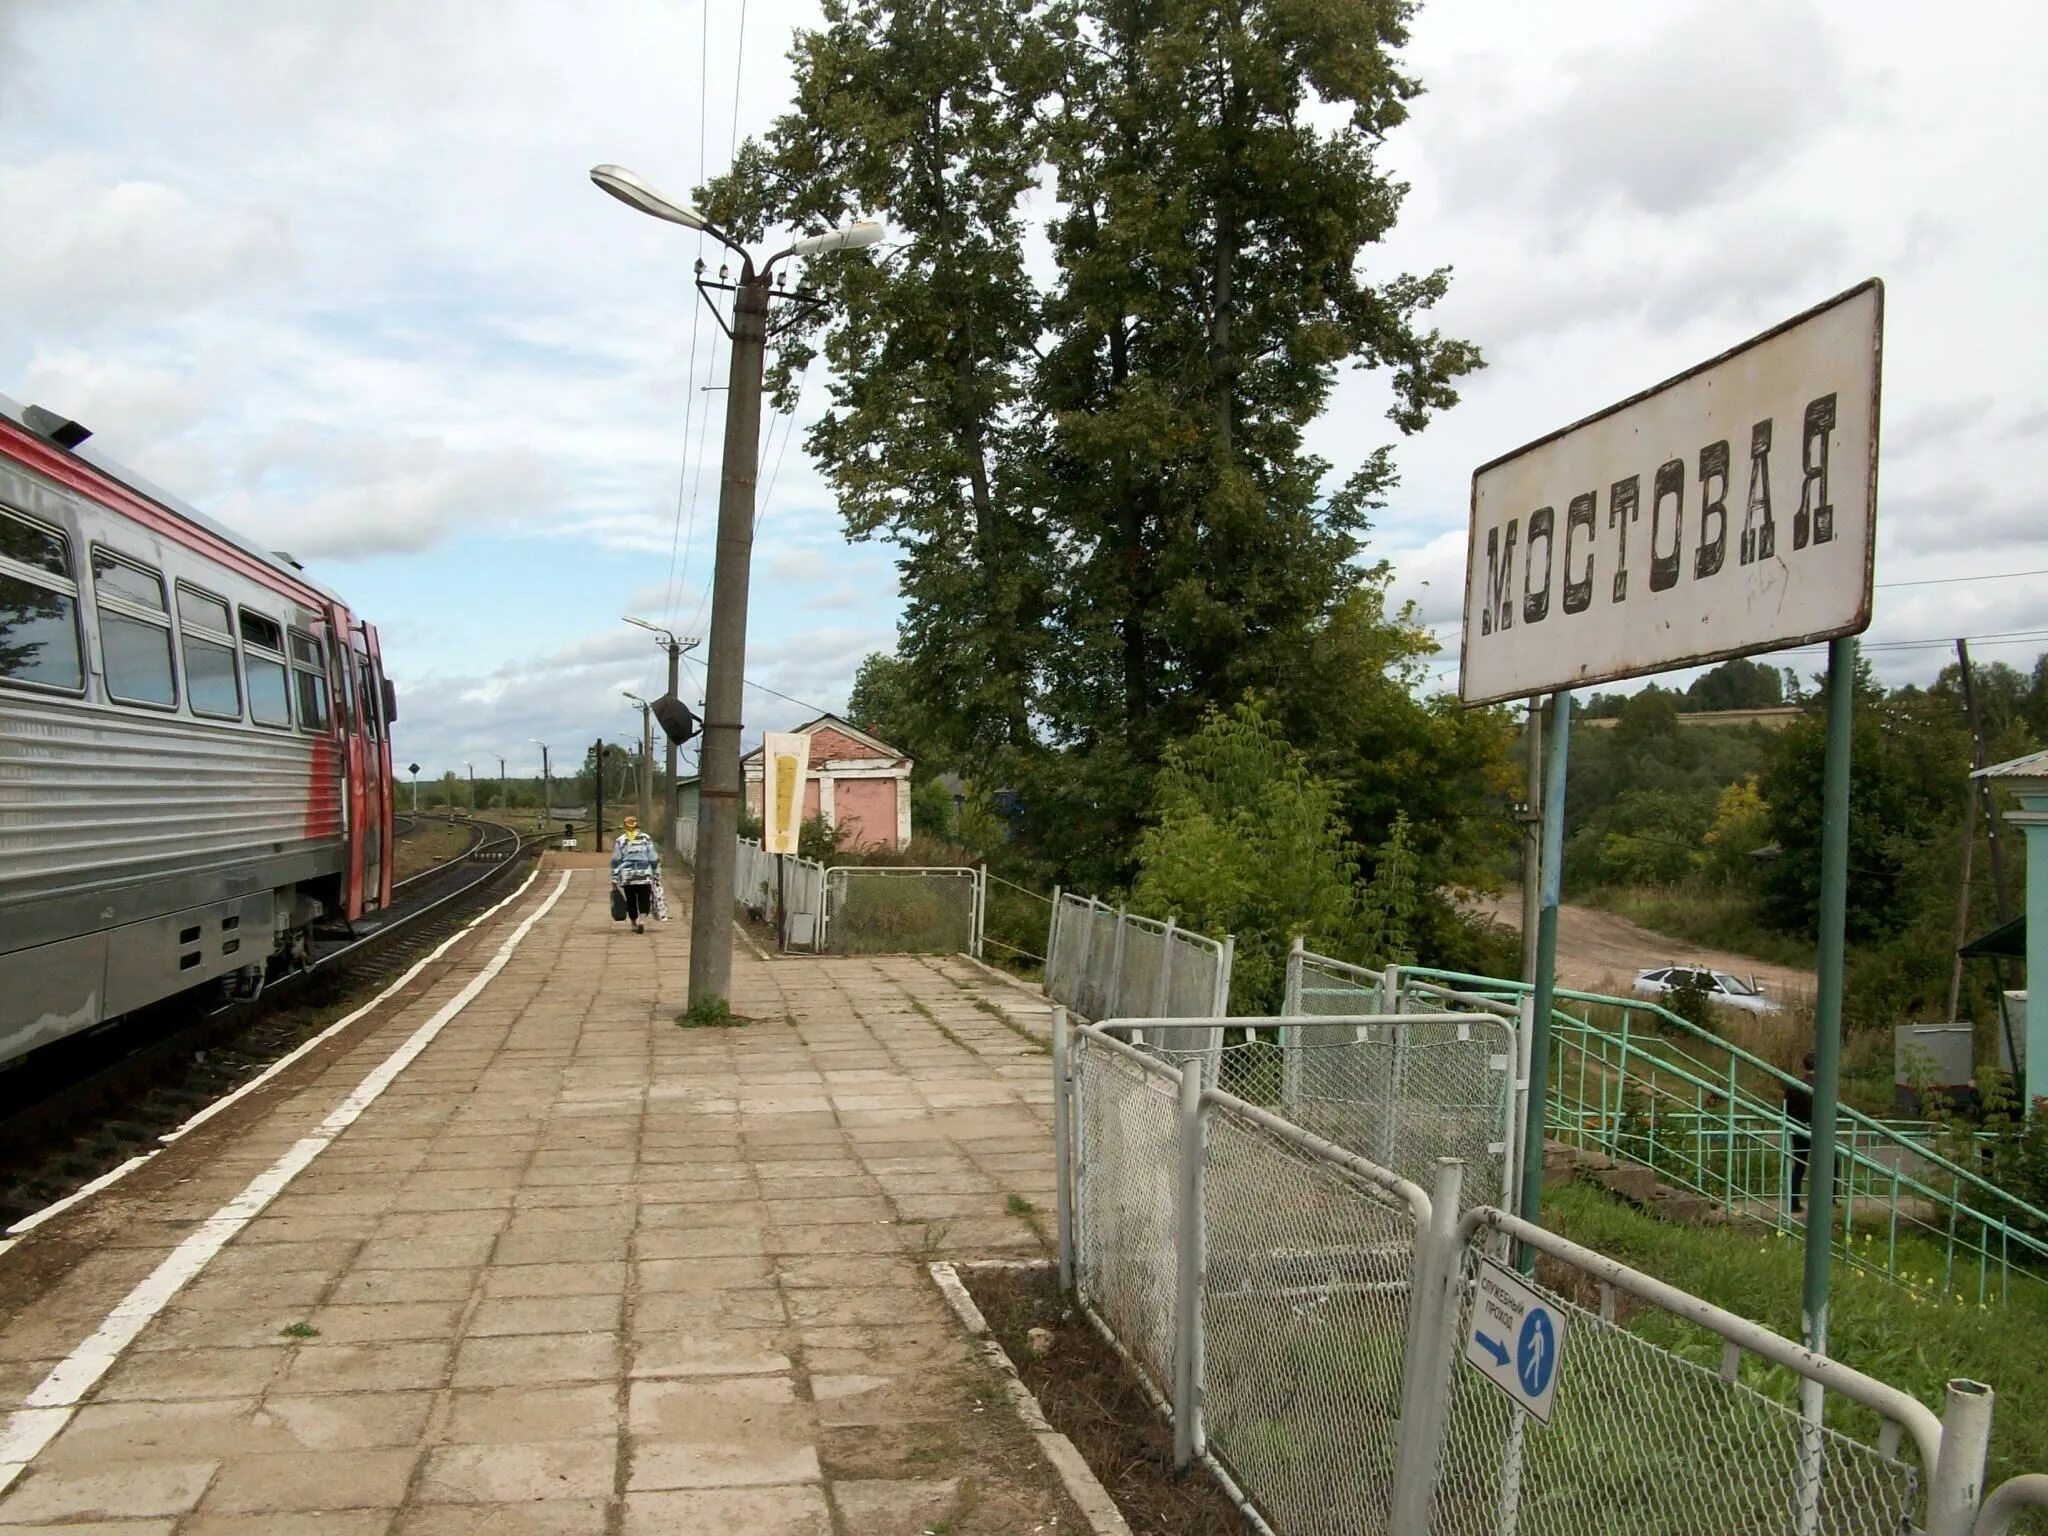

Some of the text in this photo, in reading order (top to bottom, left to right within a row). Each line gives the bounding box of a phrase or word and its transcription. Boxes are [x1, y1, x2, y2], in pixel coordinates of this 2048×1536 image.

[1482, 392, 1837, 637] МОСТОВАЯ
[1481, 1277, 1524, 1317] СЛУЖЕБНЫЙ
[1486, 1299, 1513, 1333] ПРОХОД
